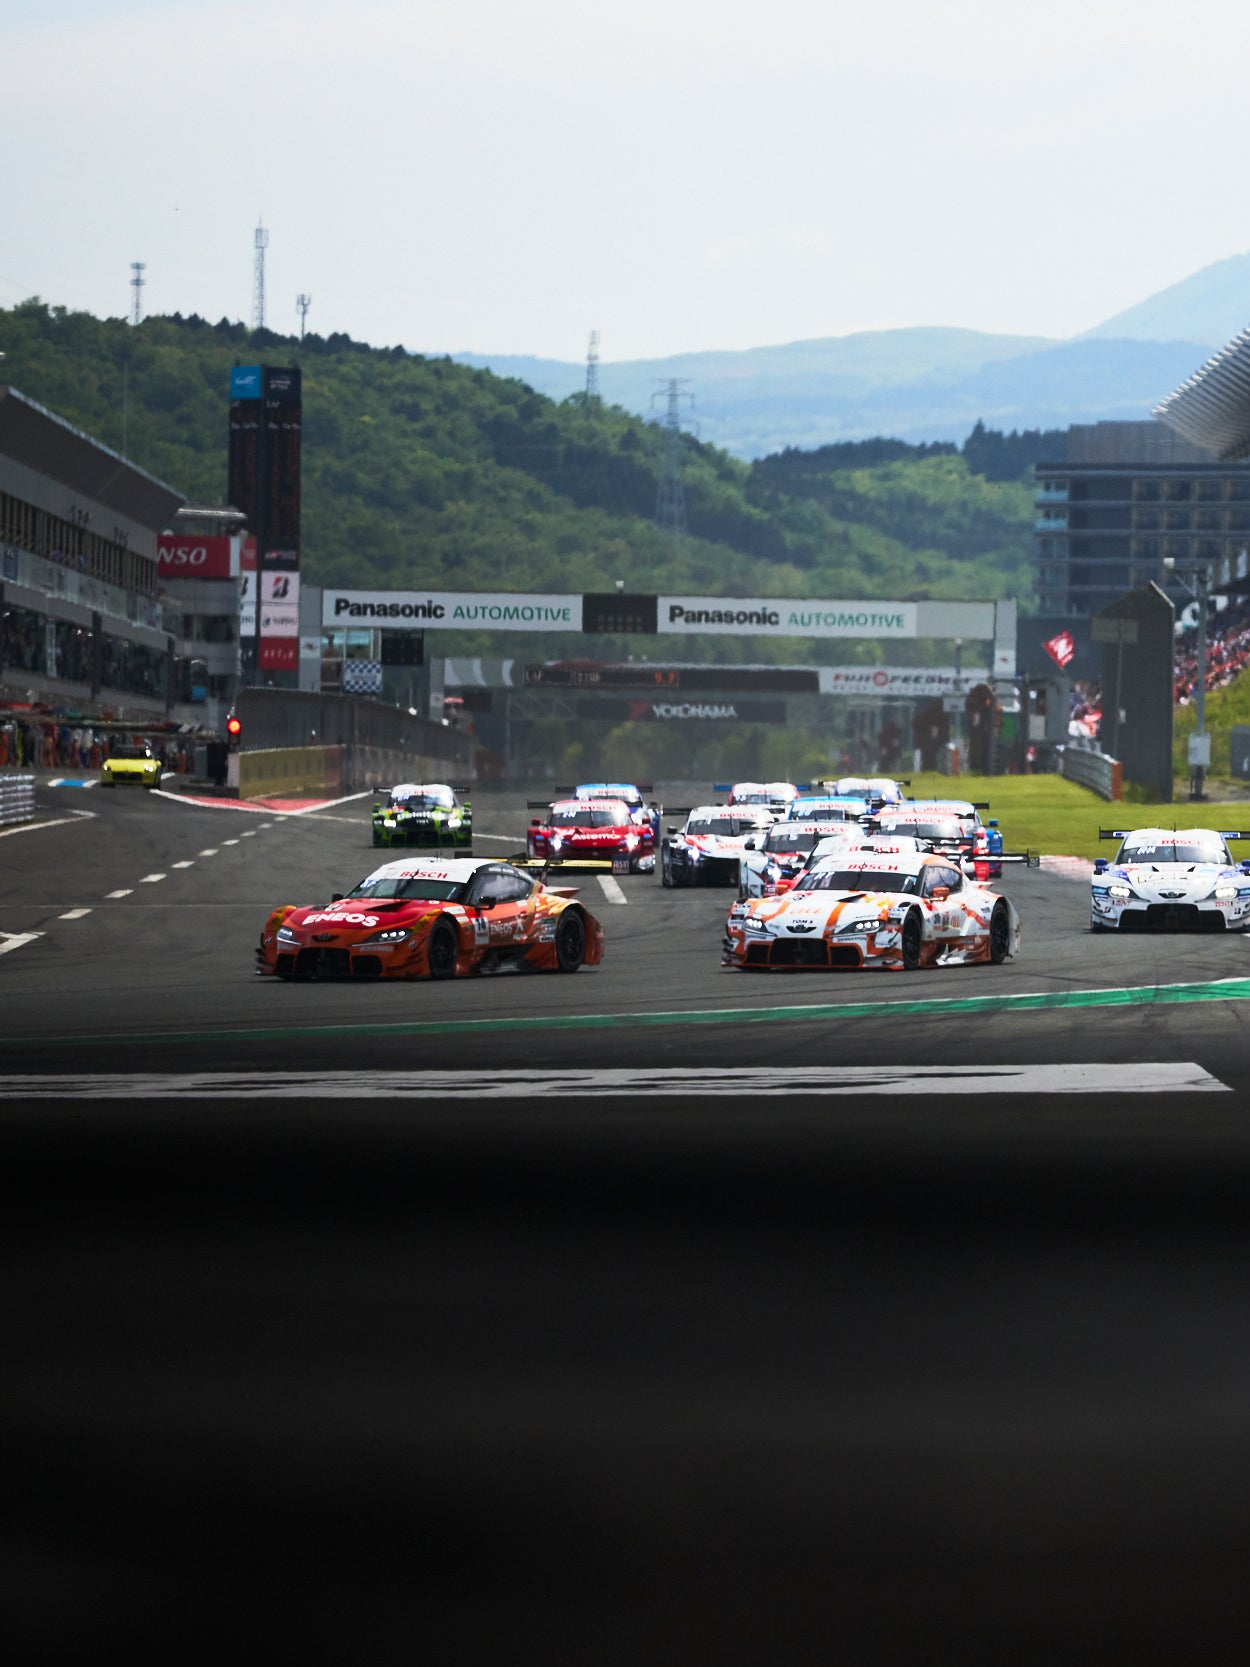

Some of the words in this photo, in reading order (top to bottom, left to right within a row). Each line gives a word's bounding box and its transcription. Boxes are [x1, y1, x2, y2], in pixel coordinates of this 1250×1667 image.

[334, 598, 446, 620] Panasonic
[453, 605, 571, 622] AUTOMOTIVE
[668, 604, 780, 626] Panasonic
[788, 611, 905, 629] AUTOMOTIVE
[652, 702, 738, 719] YOKOHAMA
[848, 846, 900, 854] BSCH
[848, 864, 900, 872] BOSCH
[400, 871, 449, 880] BOSCH
[302, 912, 380, 927] ENEOS
[475, 918, 487, 931] 14
[490, 922, 513, 935] ENEOS
